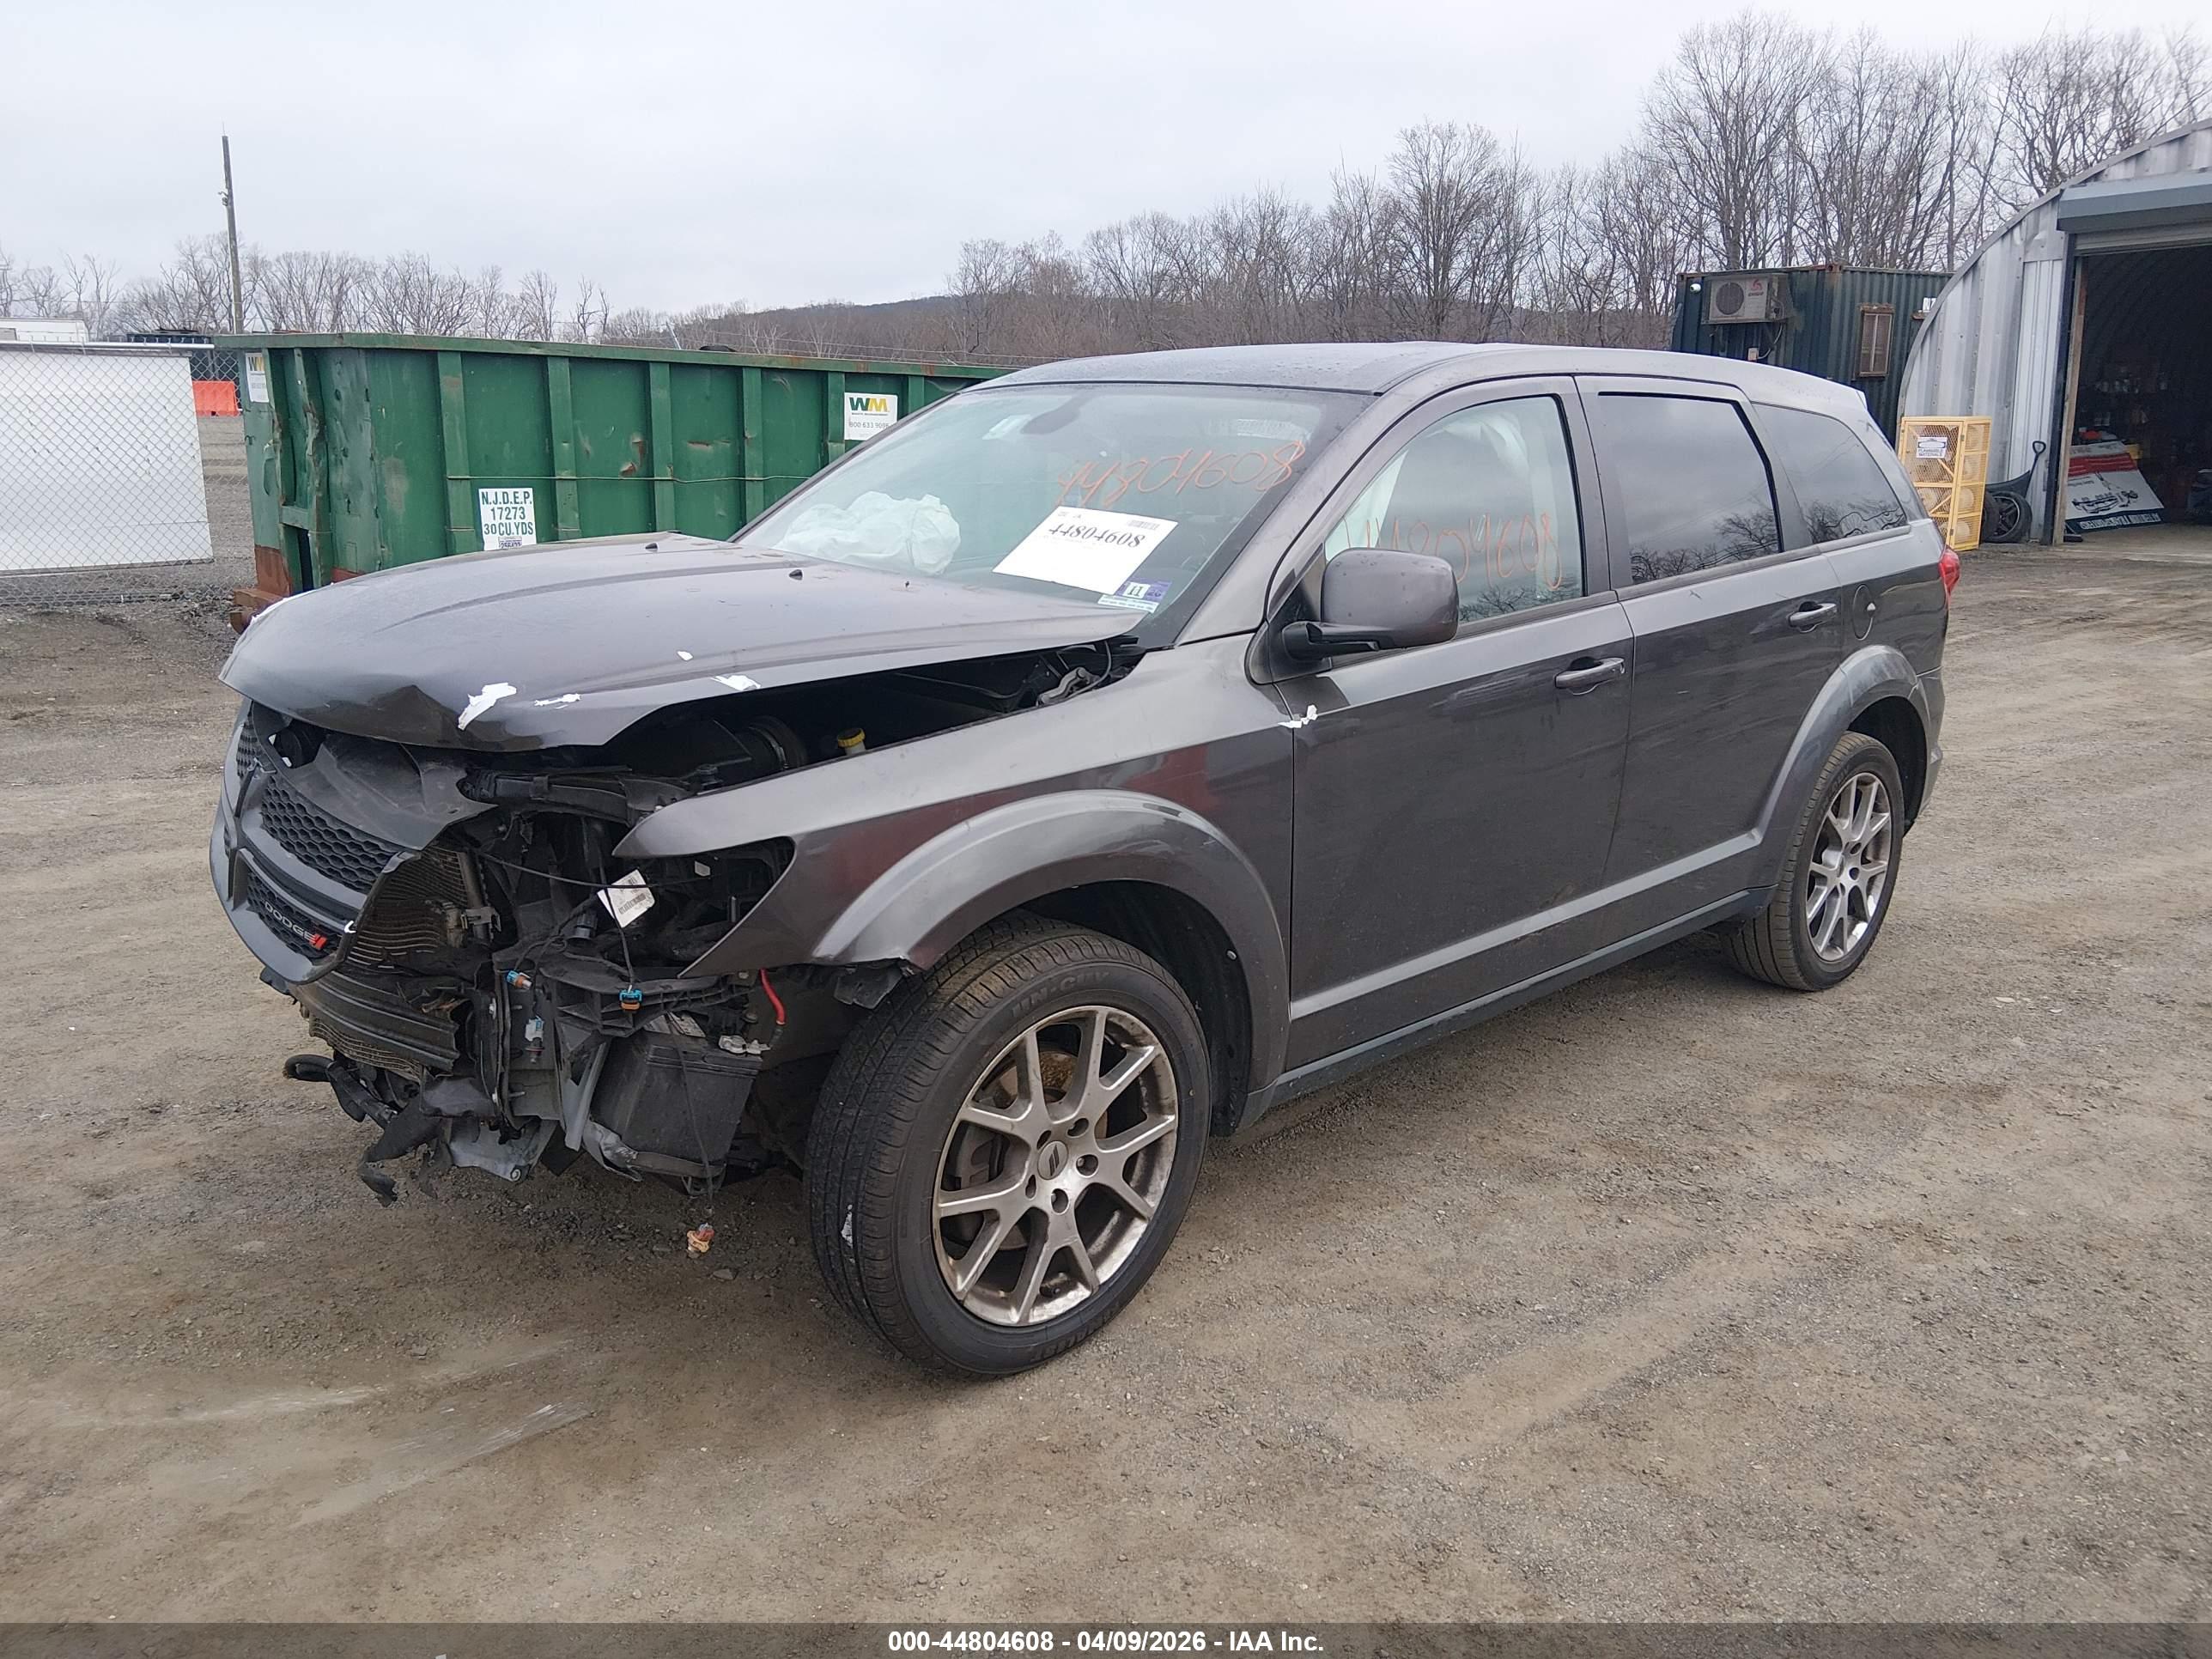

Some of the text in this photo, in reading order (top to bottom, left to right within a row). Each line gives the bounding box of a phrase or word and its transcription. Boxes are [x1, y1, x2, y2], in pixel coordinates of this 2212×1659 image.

[849, 397, 888, 412] WM
[481, 490, 532, 506] N.J.D.E.P.
[490, 507, 526, 520] 17273
[1048, 523, 1146, 548] 44804608
[264, 900, 317, 945] DODGE
